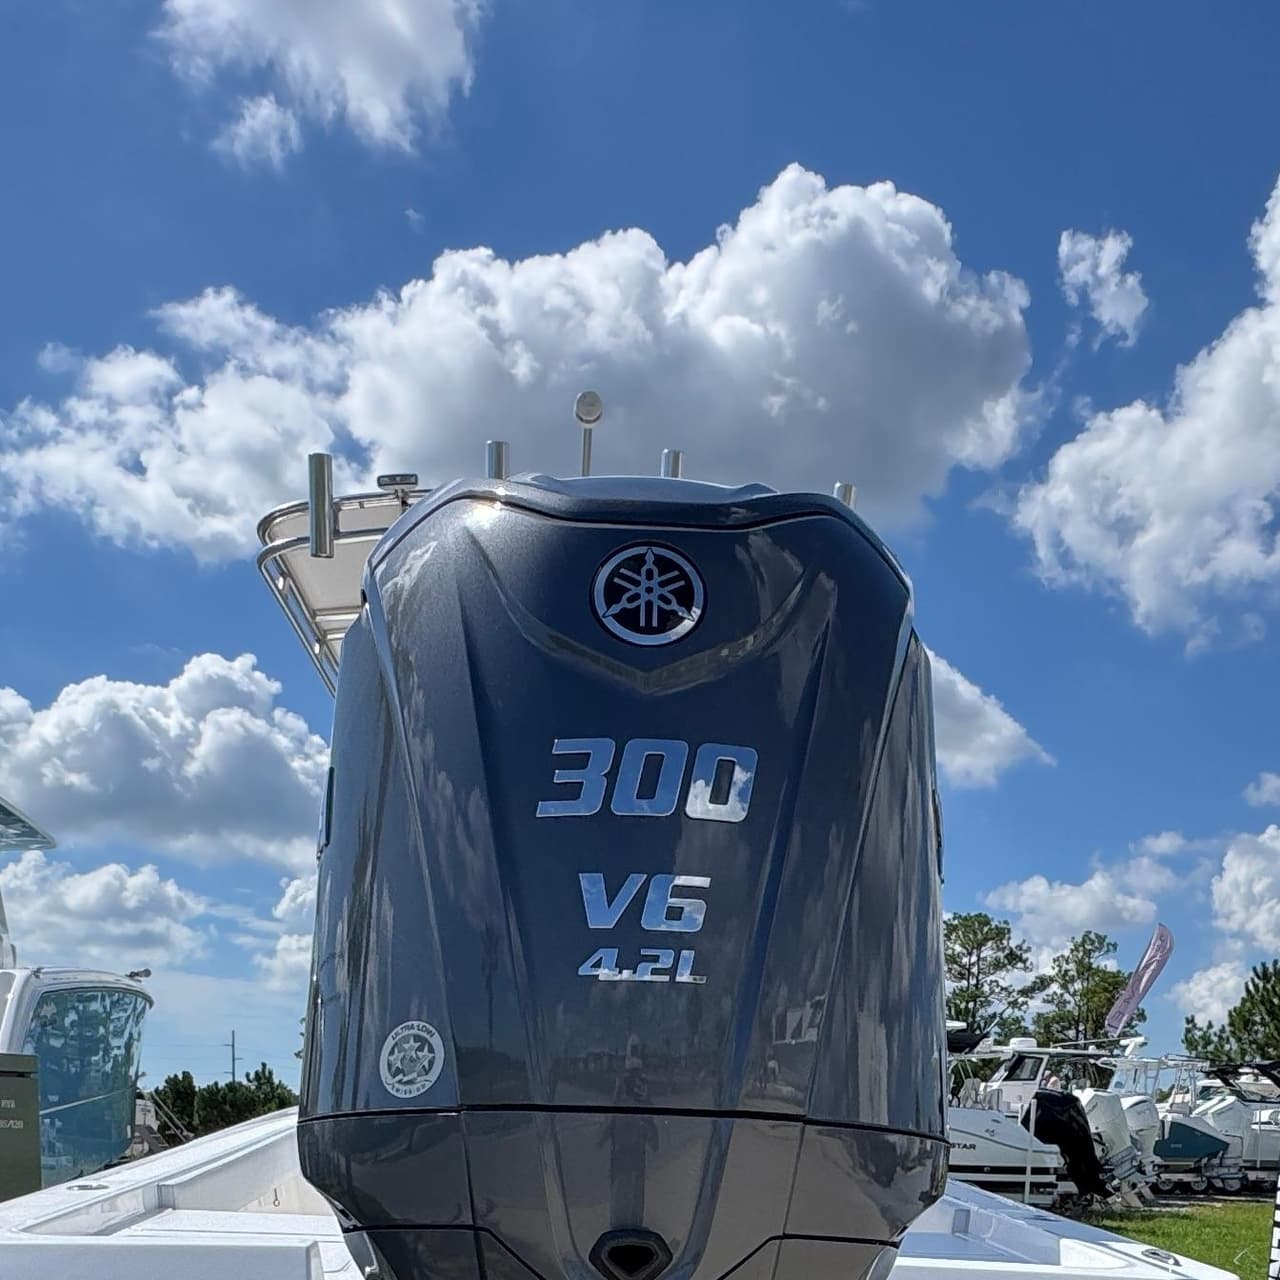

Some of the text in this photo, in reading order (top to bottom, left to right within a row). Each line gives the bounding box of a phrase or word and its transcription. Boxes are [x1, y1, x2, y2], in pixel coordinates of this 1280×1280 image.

[536, 737, 758, 823] 300
[578, 872, 712, 933] V6
[577, 947, 708, 984] 4.2L
